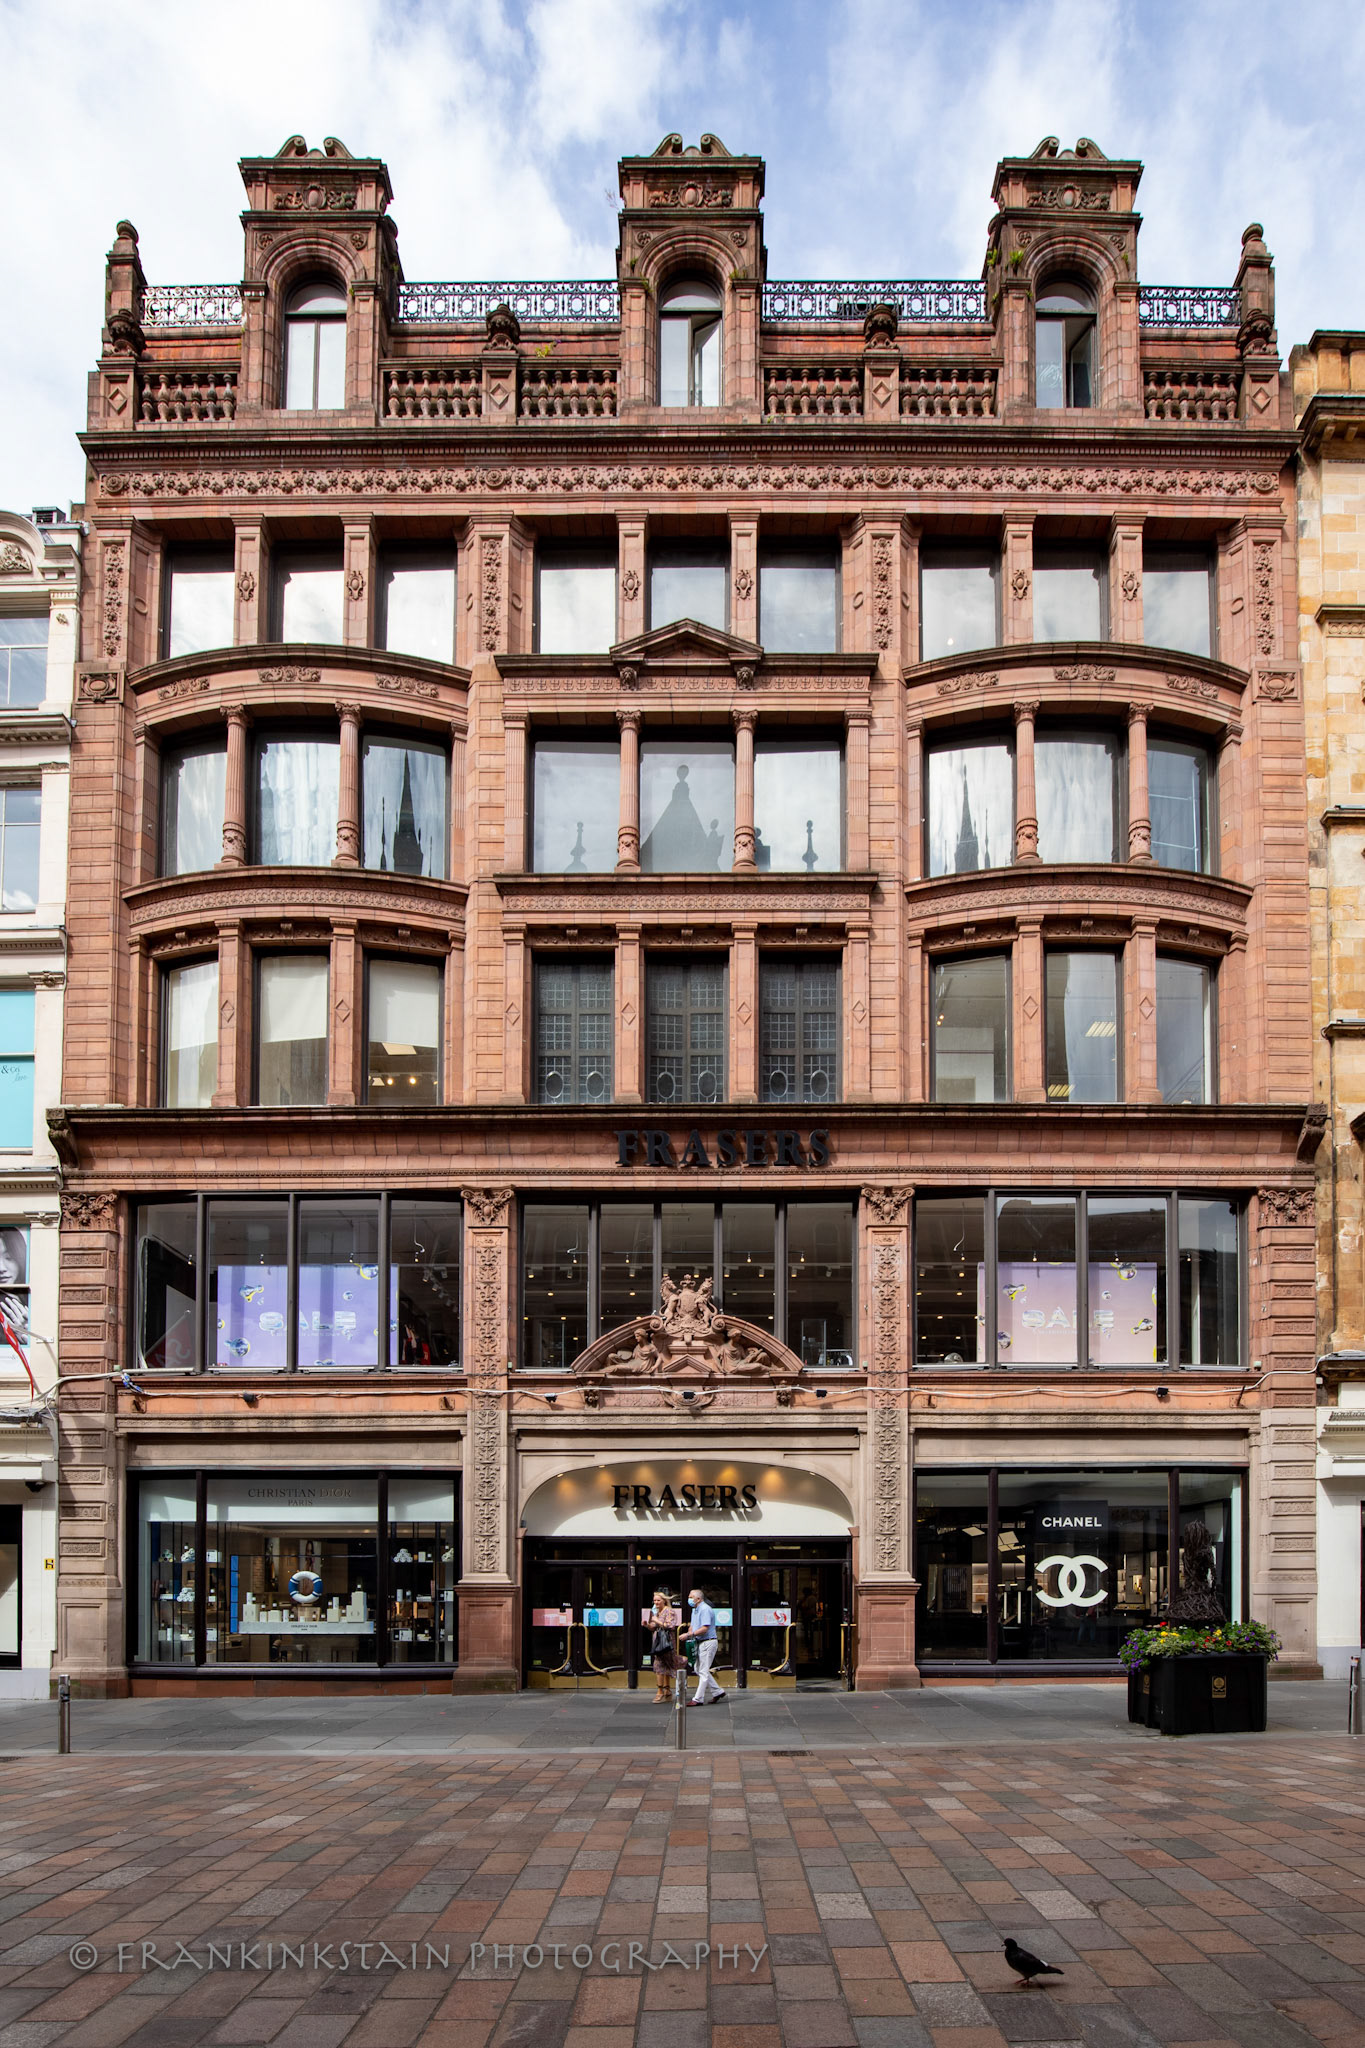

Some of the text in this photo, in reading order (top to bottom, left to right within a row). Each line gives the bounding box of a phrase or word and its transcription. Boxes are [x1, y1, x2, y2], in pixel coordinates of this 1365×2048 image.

[614, 1129, 830, 1167] FRASERS
[247, 1488, 352, 1498] CHRISTIAN DIOR
[611, 1484, 757, 1509] FRASERS
[1042, 1516, 1102, 1528] CHANEL
